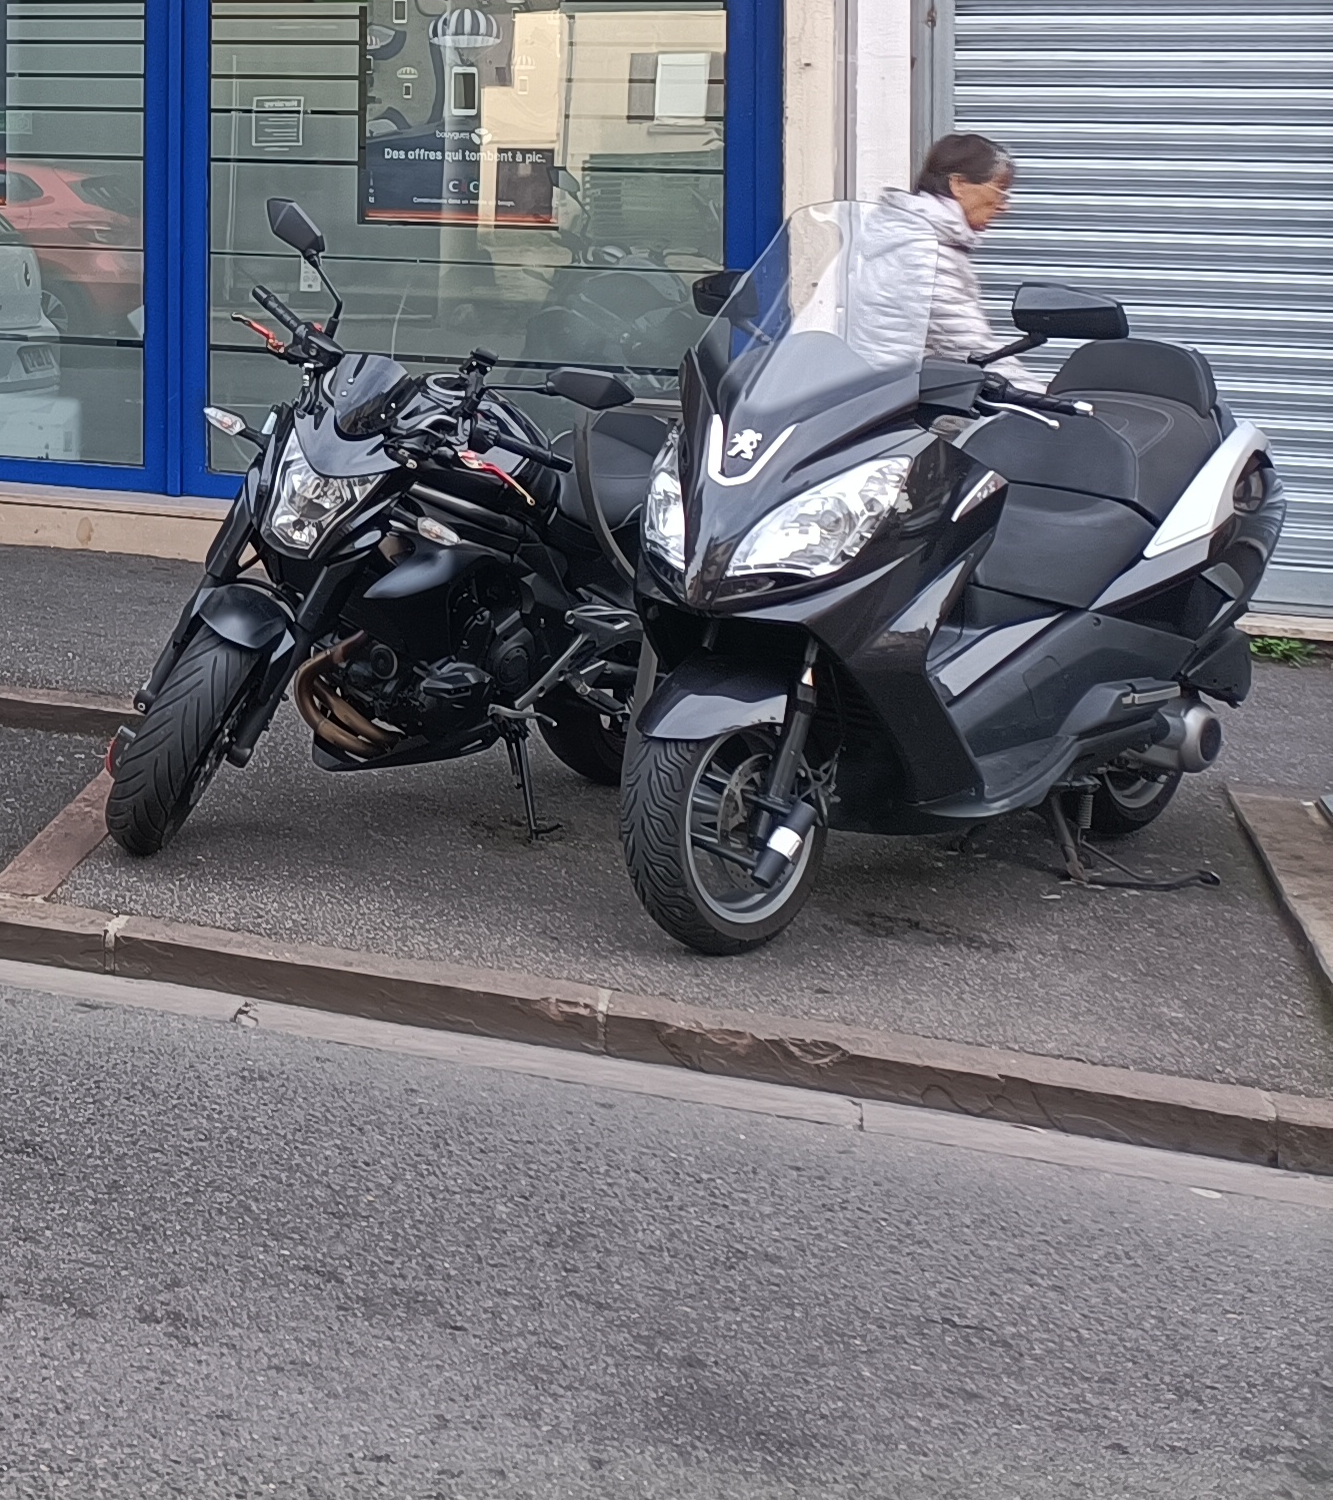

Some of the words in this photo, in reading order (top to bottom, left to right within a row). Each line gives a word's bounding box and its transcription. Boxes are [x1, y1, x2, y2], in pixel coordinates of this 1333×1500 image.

[384, 148, 406, 159] Des
[408, 148, 443, 161] offres
[445, 149, 463, 164] qui
[465, 150, 513, 163] tombent
[515, 151, 523, 163] à
[525, 152, 546, 165] pic.
